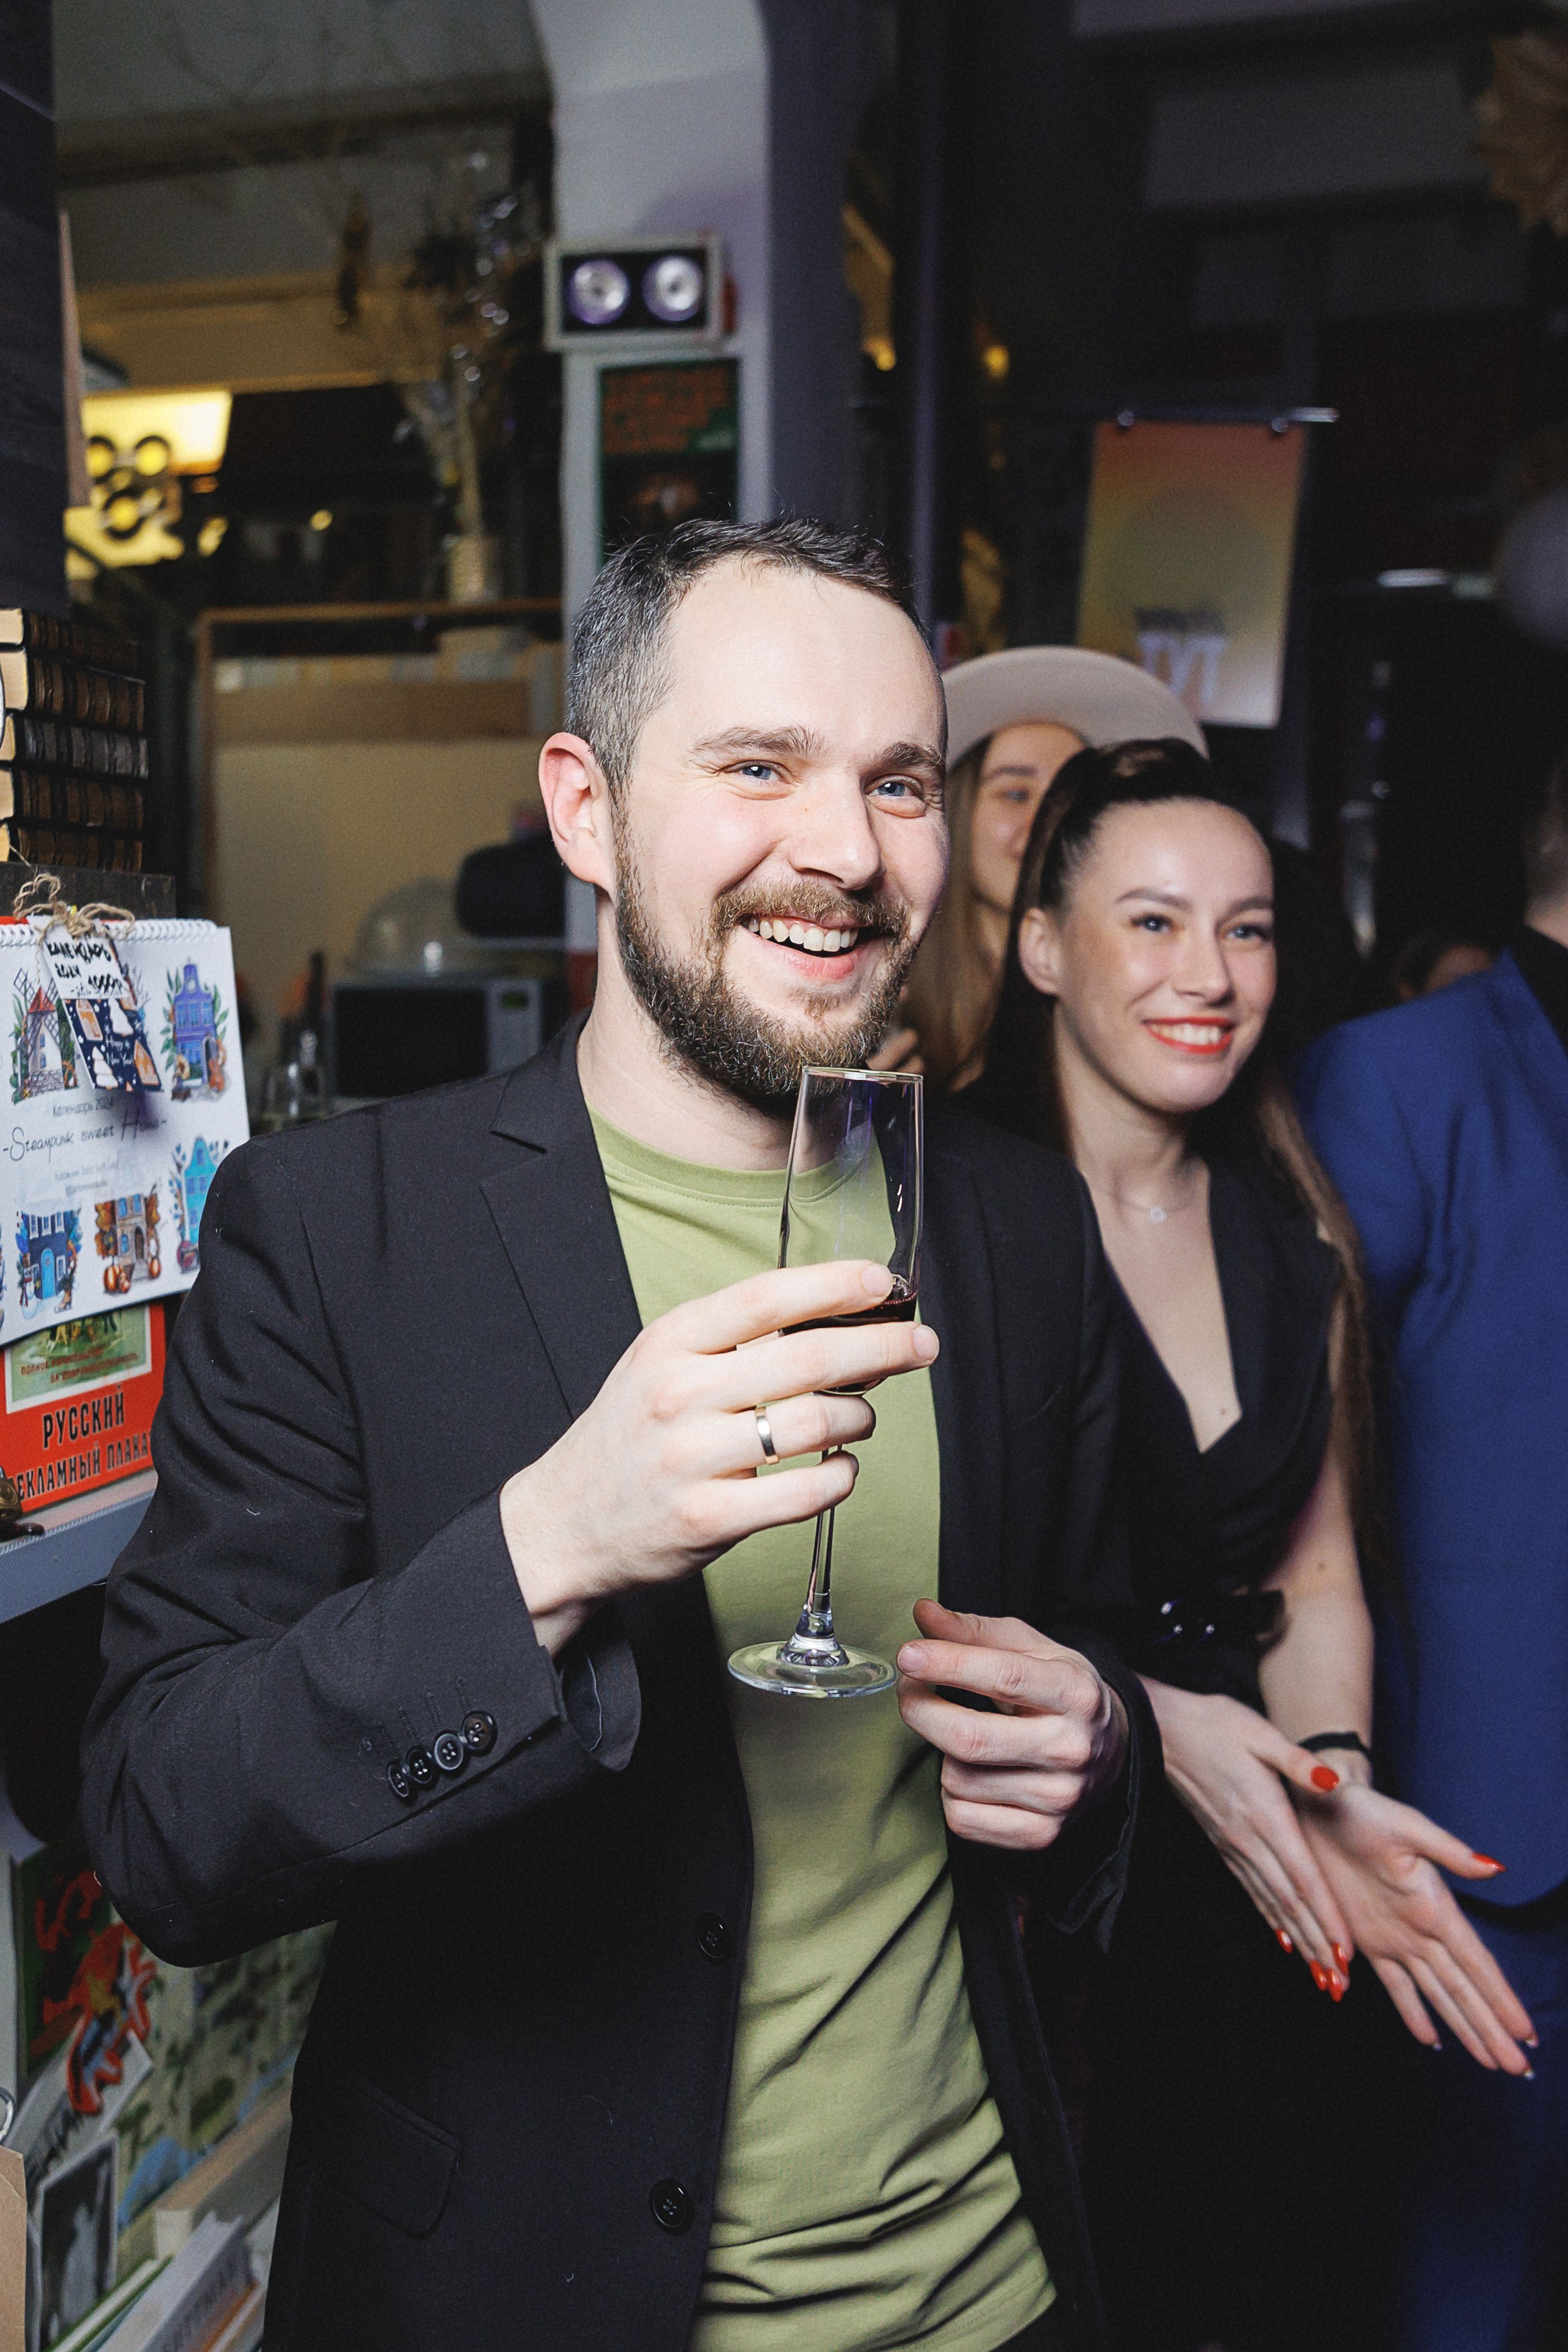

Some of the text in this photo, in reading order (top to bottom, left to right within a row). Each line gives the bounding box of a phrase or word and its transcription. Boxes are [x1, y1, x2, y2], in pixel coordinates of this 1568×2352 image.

[81, 1124, 114, 1142] sweet
[43, 1384, 124, 1450] РУССКИЙ
[8, 1430, 151, 1502] ЕКЛАМНЫЙ ПЛАКА
